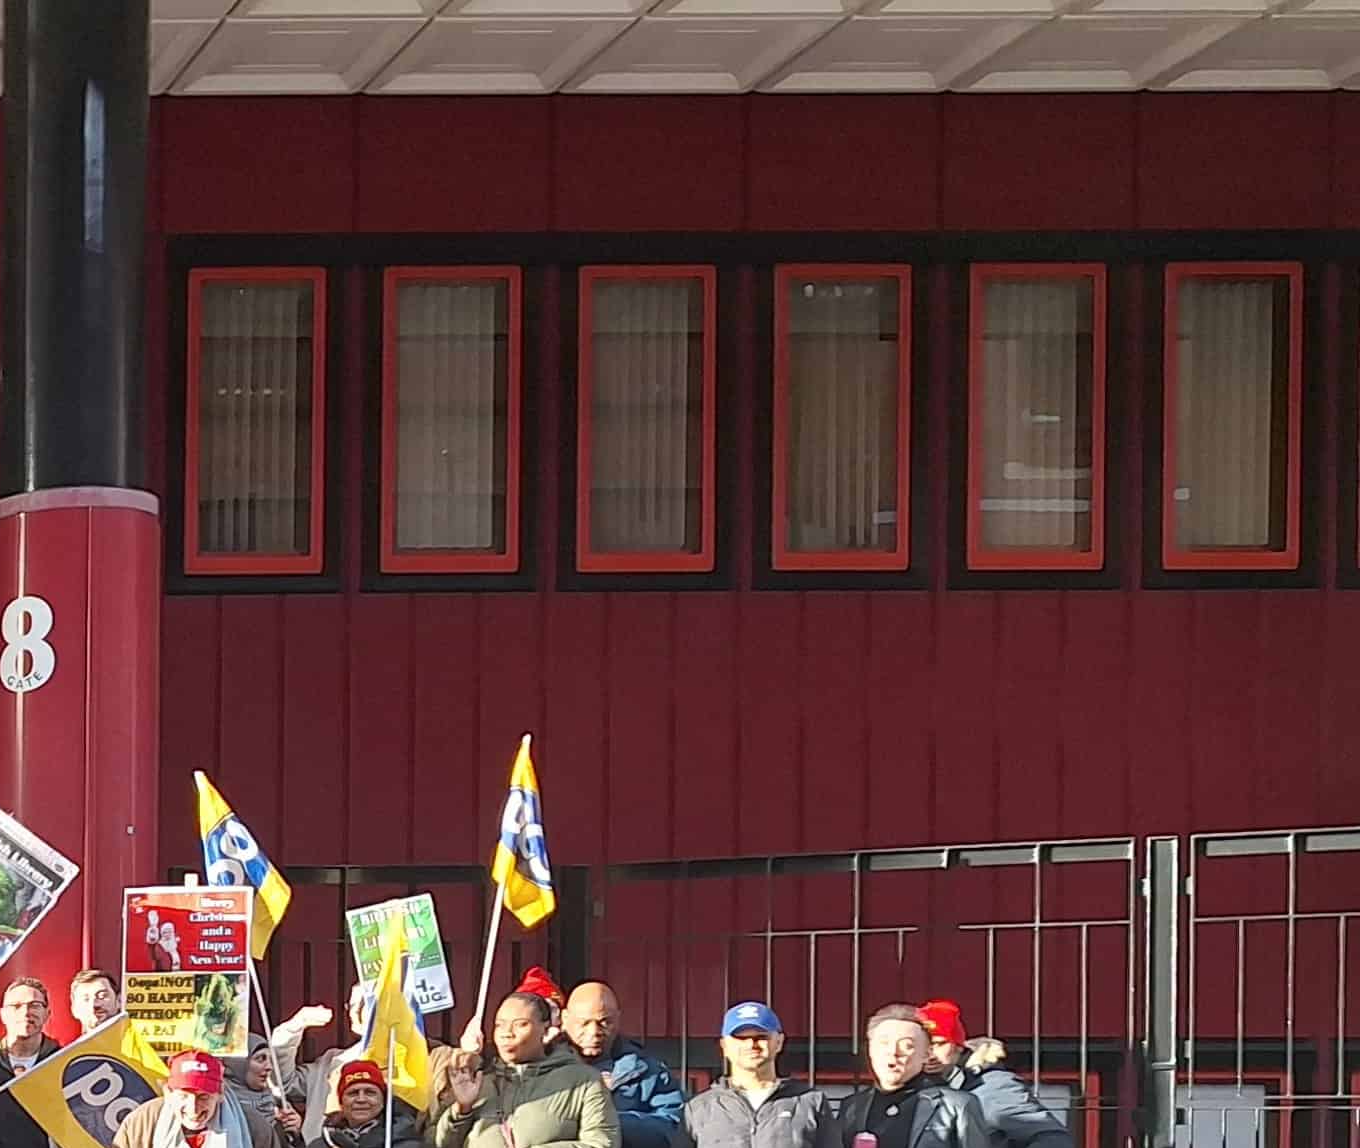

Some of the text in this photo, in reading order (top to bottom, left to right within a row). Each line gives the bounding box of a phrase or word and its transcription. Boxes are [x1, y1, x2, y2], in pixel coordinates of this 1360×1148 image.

[0, 596, 56, 692] 8
[7, 672, 43, 689] GATE
[201, 924, 224, 936] and
[199, 940, 235, 953] Happy
[127, 992, 146, 1004] SO
[126, 1008, 194, 1020] WITHOUT
